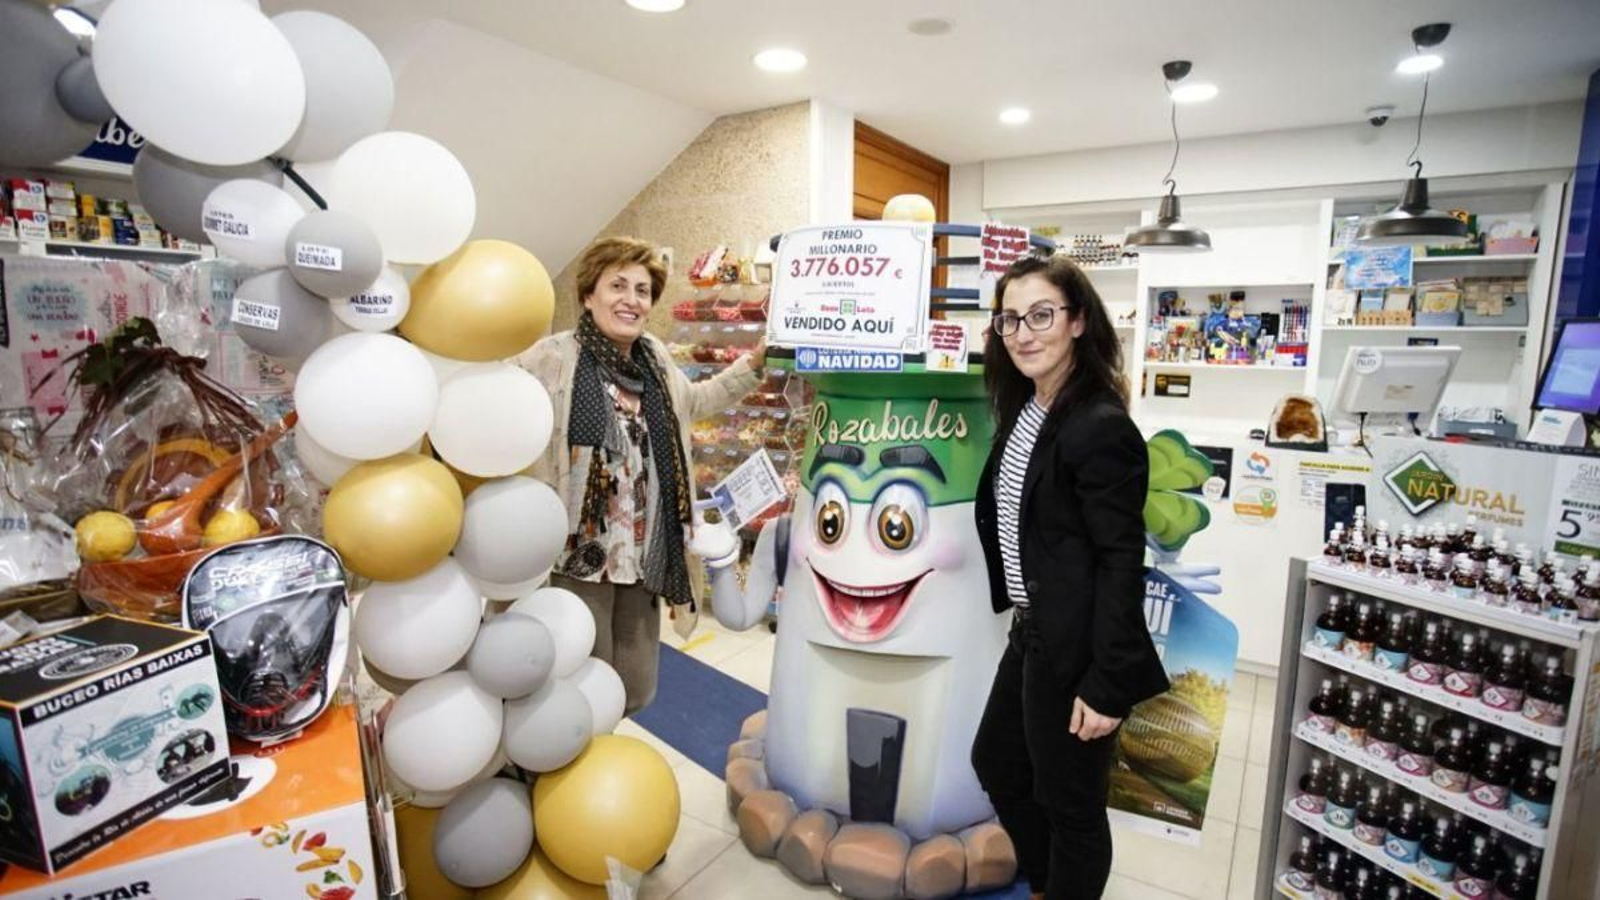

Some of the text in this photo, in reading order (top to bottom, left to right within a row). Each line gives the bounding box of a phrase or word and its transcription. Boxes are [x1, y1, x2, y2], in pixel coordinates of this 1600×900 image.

[822, 229, 863, 240] PREMIO
[808, 244, 878, 256] MILLONARIO
[298, 252, 336, 267] QUEIMADA
[790, 257, 903, 279] 3.776.057 €
[784, 316, 895, 334] VENDIDO AQUÍ
[818, 354, 899, 369] NAVIDAD
[811, 398, 968, 446] Rozabales
[1407, 478, 1525, 514] NATURAL
[1146, 581, 1169, 598] CAE
[32, 644, 204, 719] BUCEO RÍAS BAIXAS
